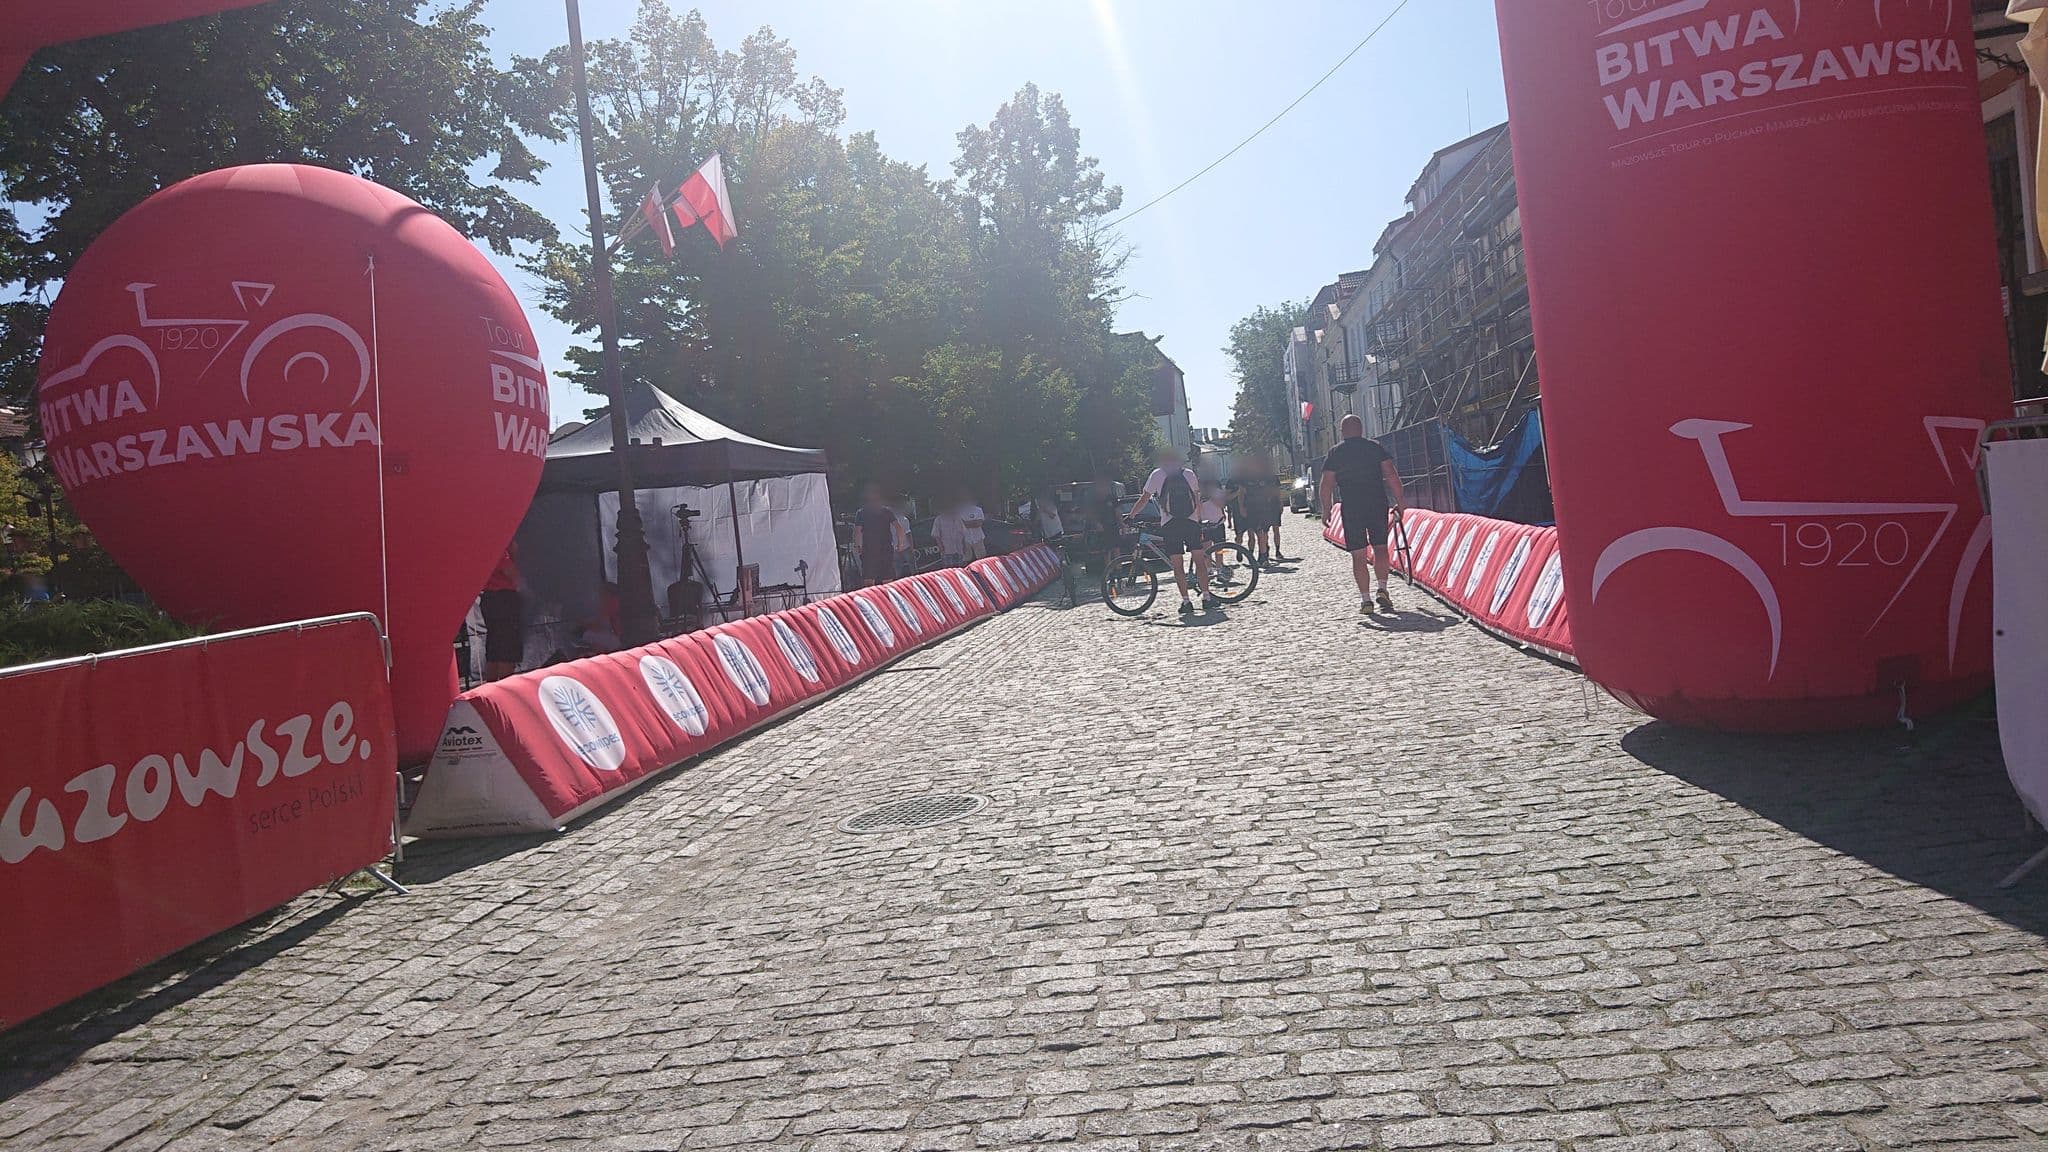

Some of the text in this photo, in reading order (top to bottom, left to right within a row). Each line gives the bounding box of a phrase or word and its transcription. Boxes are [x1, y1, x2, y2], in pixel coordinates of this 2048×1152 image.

[1587, 0, 1656, 24] Tou
[1595, 8, 1784, 87] BITWA
[1603, 38, 1964, 131] WARSZAWSKA
[156, 327, 220, 351] 1920
[479, 315, 526, 351] Tour
[40, 379, 148, 444] BITWA
[494, 411, 550, 463] WAR
[51, 411, 383, 491] WARSZAWSKA
[1770, 521, 1909, 567] 1920
[441, 735, 483, 747] Aviotex
[249, 773, 365, 833] serce Polski
